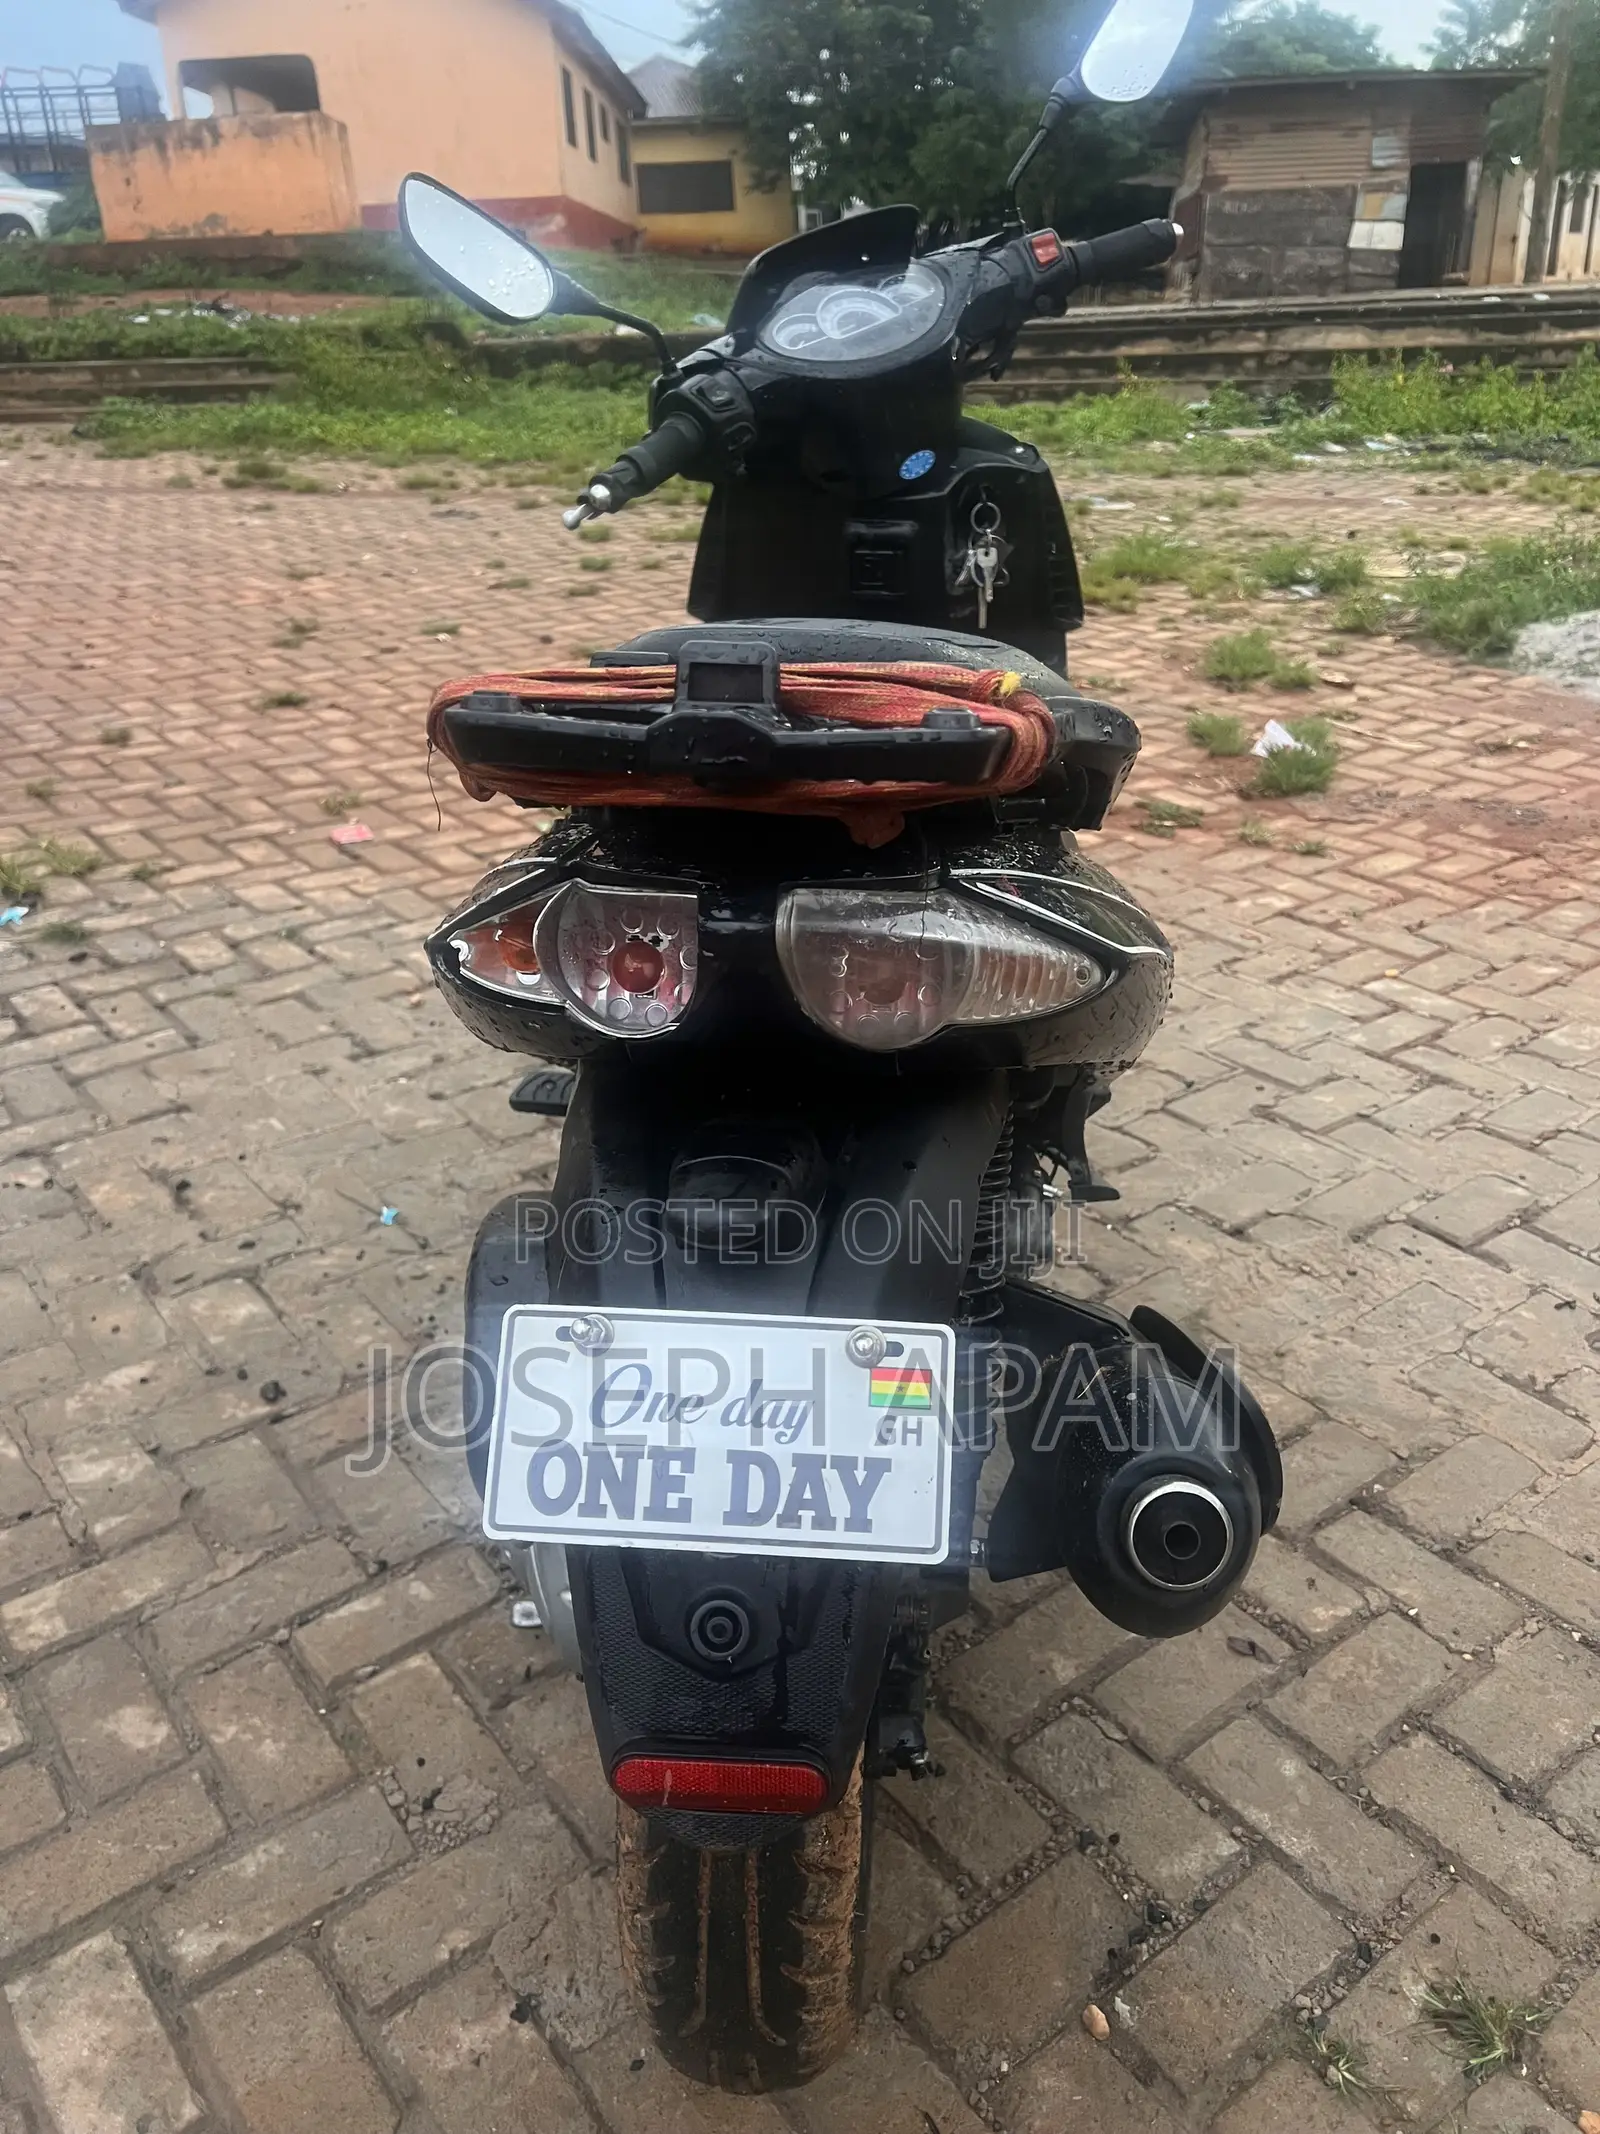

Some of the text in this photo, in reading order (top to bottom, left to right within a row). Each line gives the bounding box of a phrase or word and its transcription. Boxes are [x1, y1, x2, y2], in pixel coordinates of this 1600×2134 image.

[588, 1363, 816, 1443] One day
[876, 1414, 923, 1446] GH
[526, 1438, 892, 1533] ONE DAY
